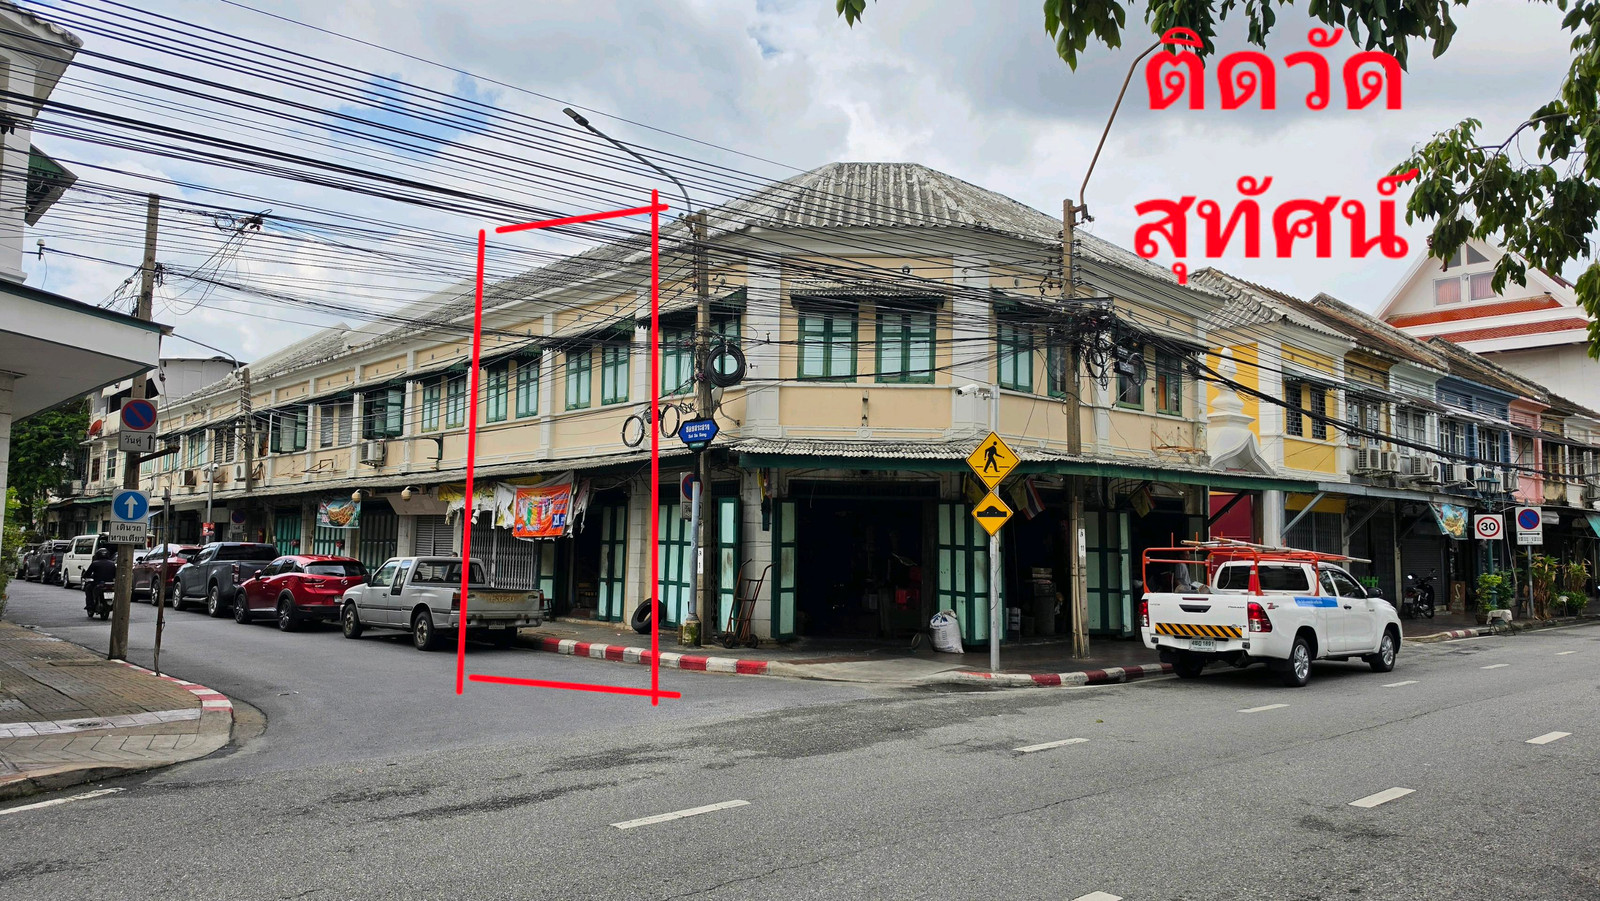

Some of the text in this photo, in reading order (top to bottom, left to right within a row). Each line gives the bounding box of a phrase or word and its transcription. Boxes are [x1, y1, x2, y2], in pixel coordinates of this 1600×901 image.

[116, 522, 141, 532] เดินรถ
[1481, 522, 1496, 531] 30
[110, 533, 145, 543] ทางเดียว
